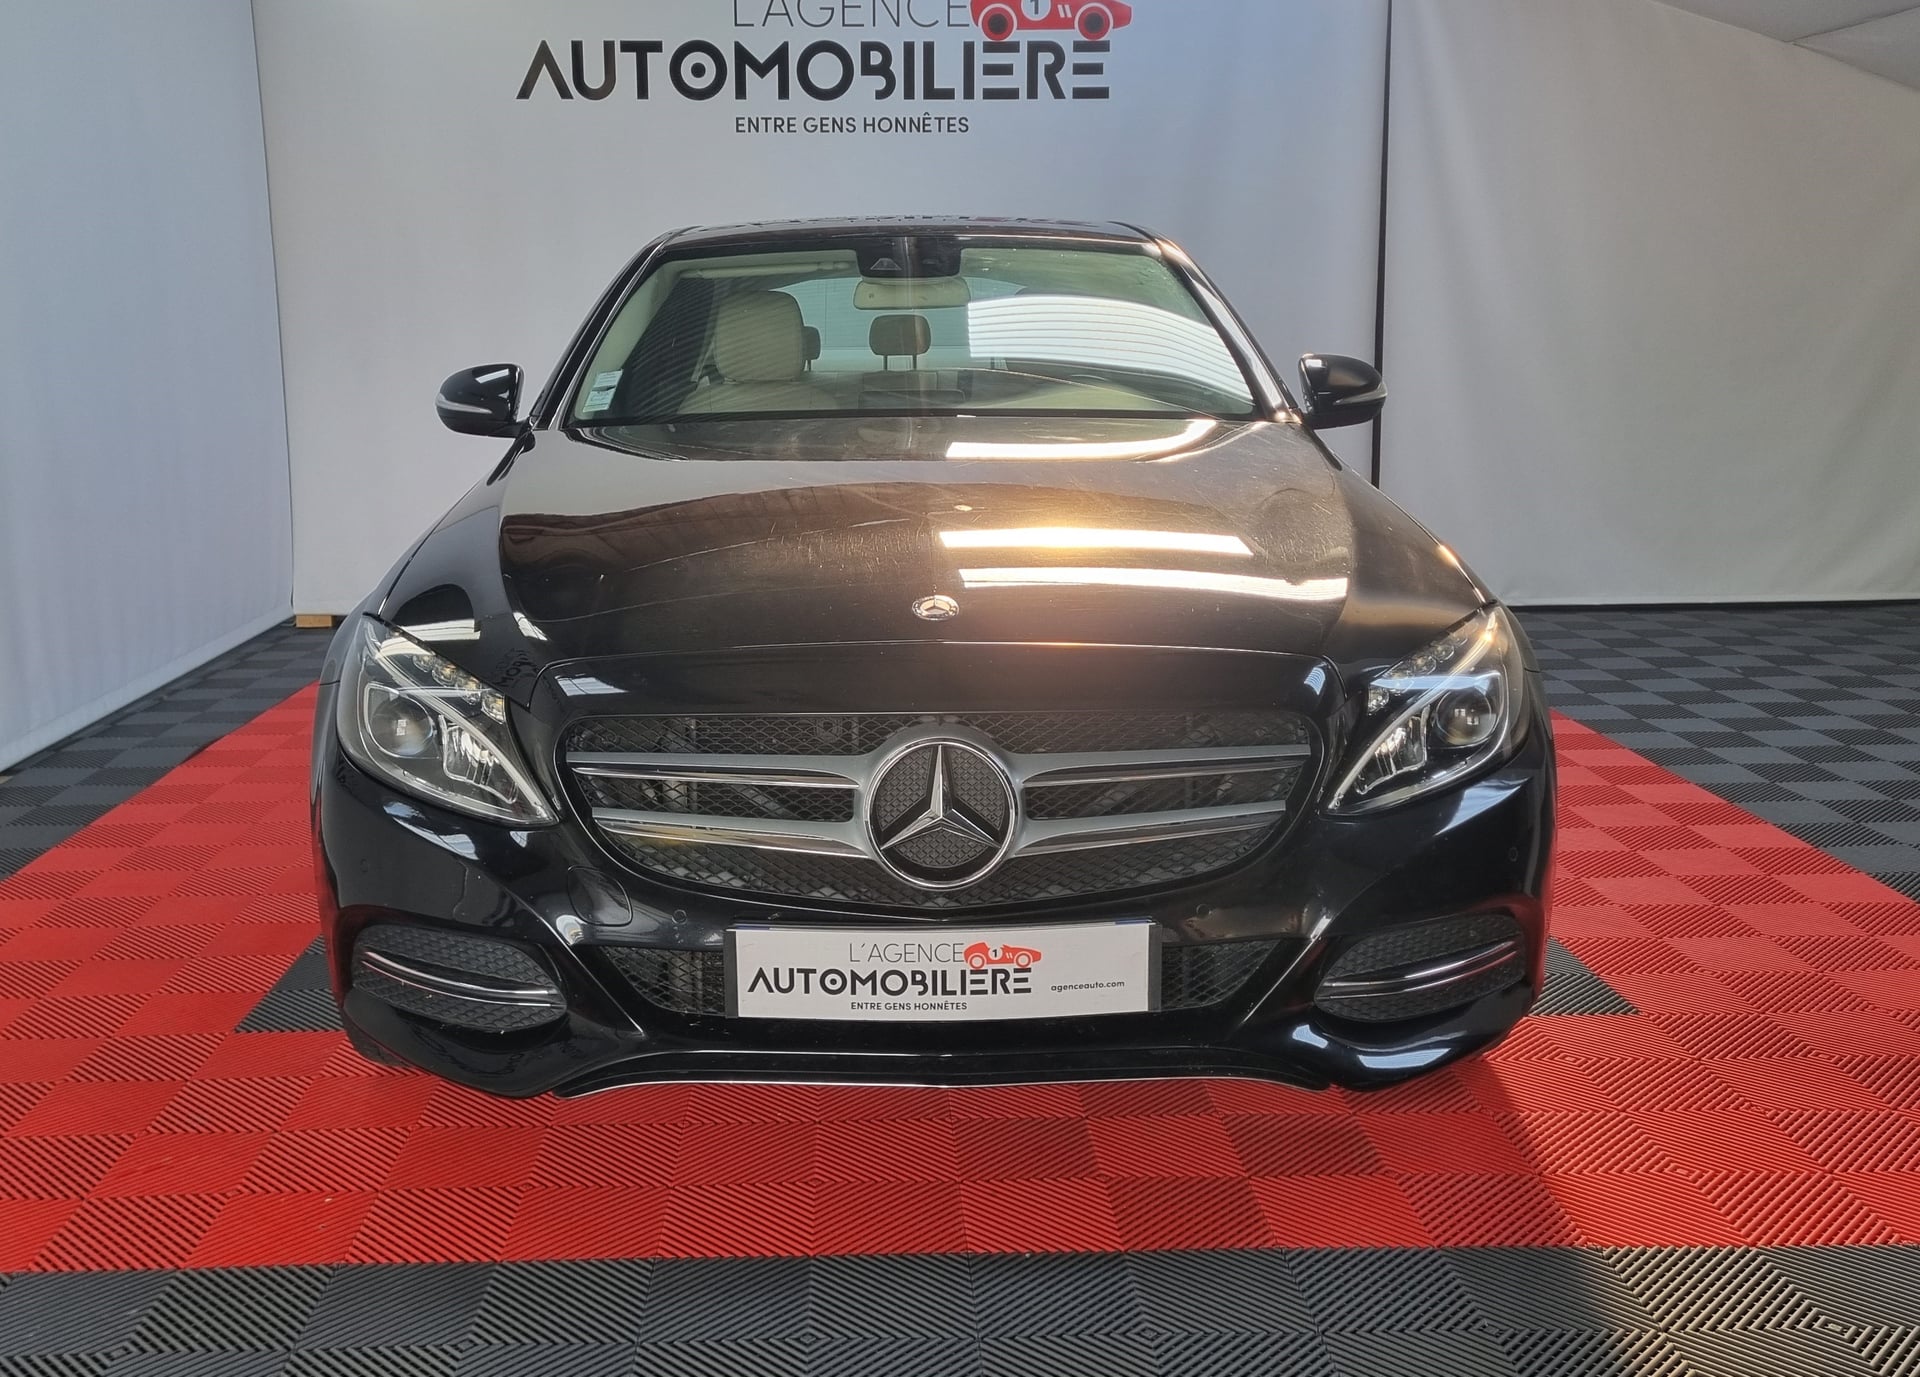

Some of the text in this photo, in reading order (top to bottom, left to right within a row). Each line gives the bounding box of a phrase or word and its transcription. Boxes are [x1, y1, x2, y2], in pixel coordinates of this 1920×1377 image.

[734, 0, 970, 28] LAGENCE
[1029, 0, 1040, 15] 1
[516, 40, 1110, 101] AUTOMOBILIERE
[736, 112, 969, 133] ENTRE GENS HONNÊTES
[849, 943, 965, 962] L'AGENCE
[992, 949, 998, 958] 1
[747, 967, 1032, 996] AUTOMOBILIERE
[1050, 979, 1125, 993] agenceauto.com
[851, 1000, 967, 1011] ENTRE GENS HONNÊTES
